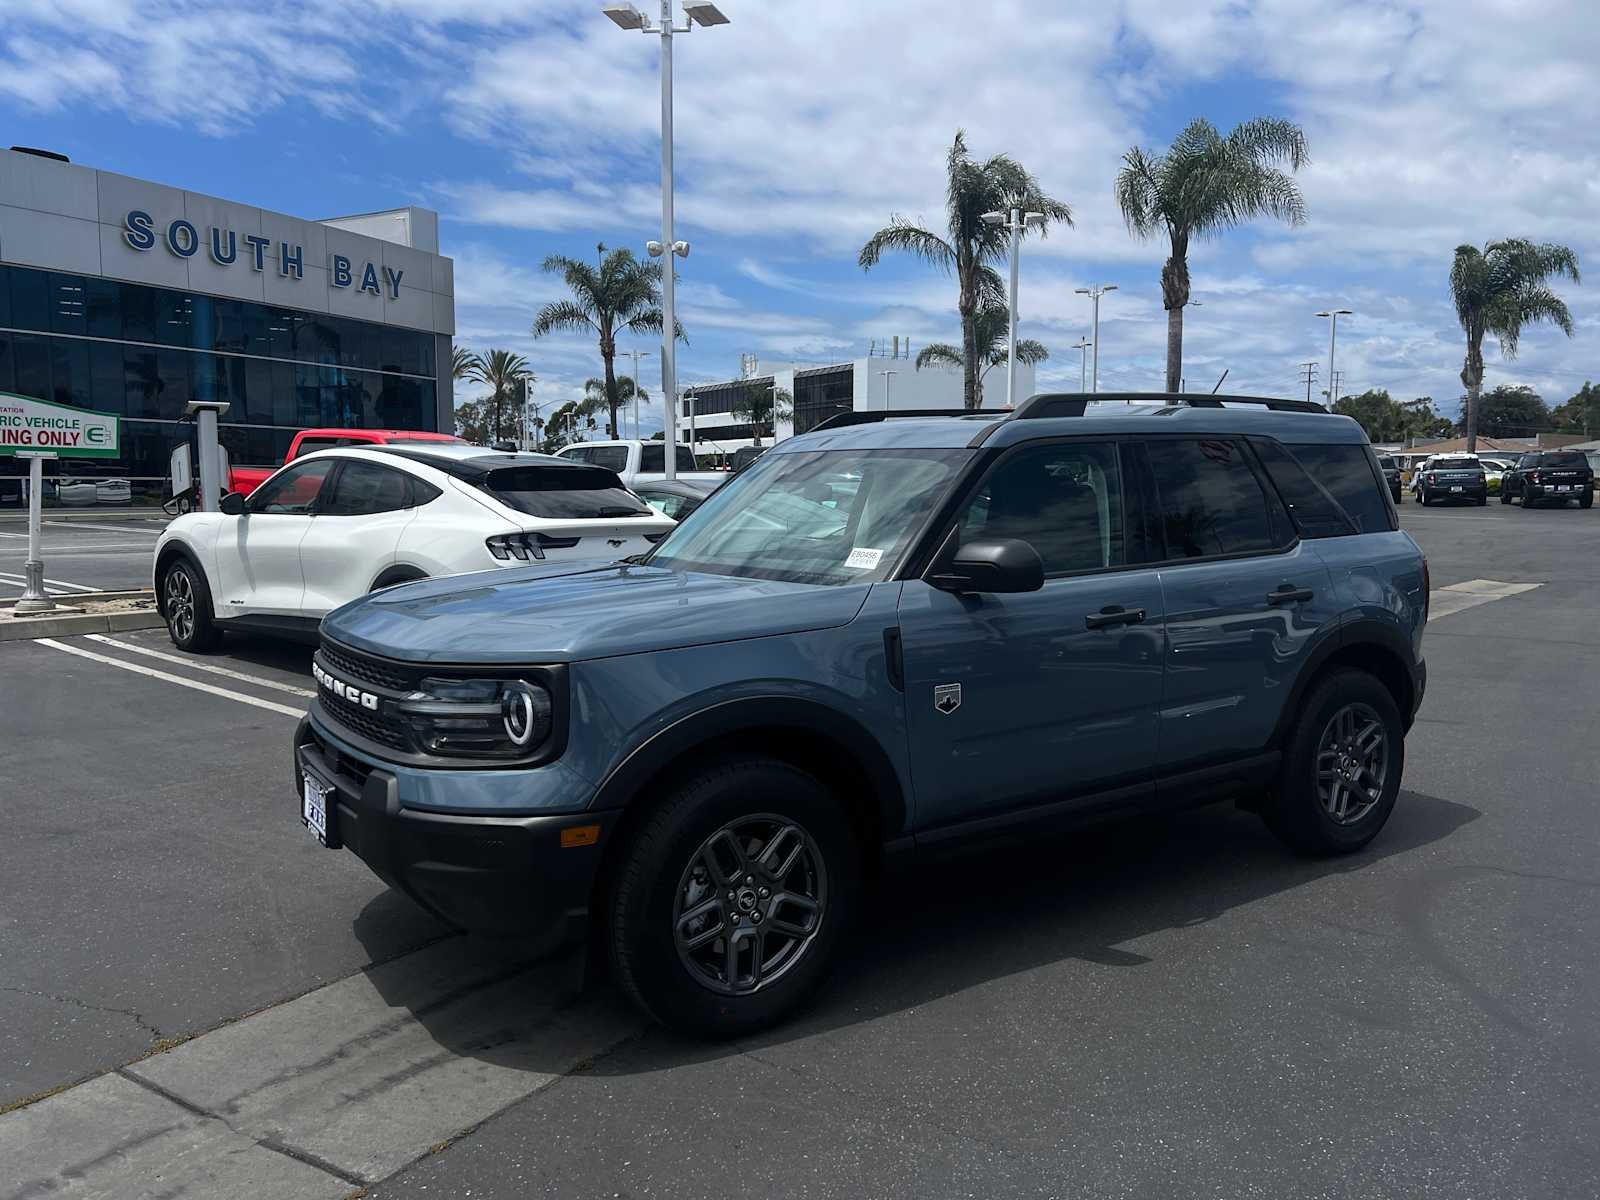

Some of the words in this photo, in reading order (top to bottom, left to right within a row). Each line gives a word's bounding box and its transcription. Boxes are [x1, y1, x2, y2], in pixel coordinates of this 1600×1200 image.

[124, 210, 304, 279] SOUTH
[332, 254, 404, 299] BAY
[0, 429, 32, 445] ING
[37, 430, 80, 446] ONLY
[25, 417, 80, 429] VEHICLE
[312, 662, 378, 711] BRONCO
